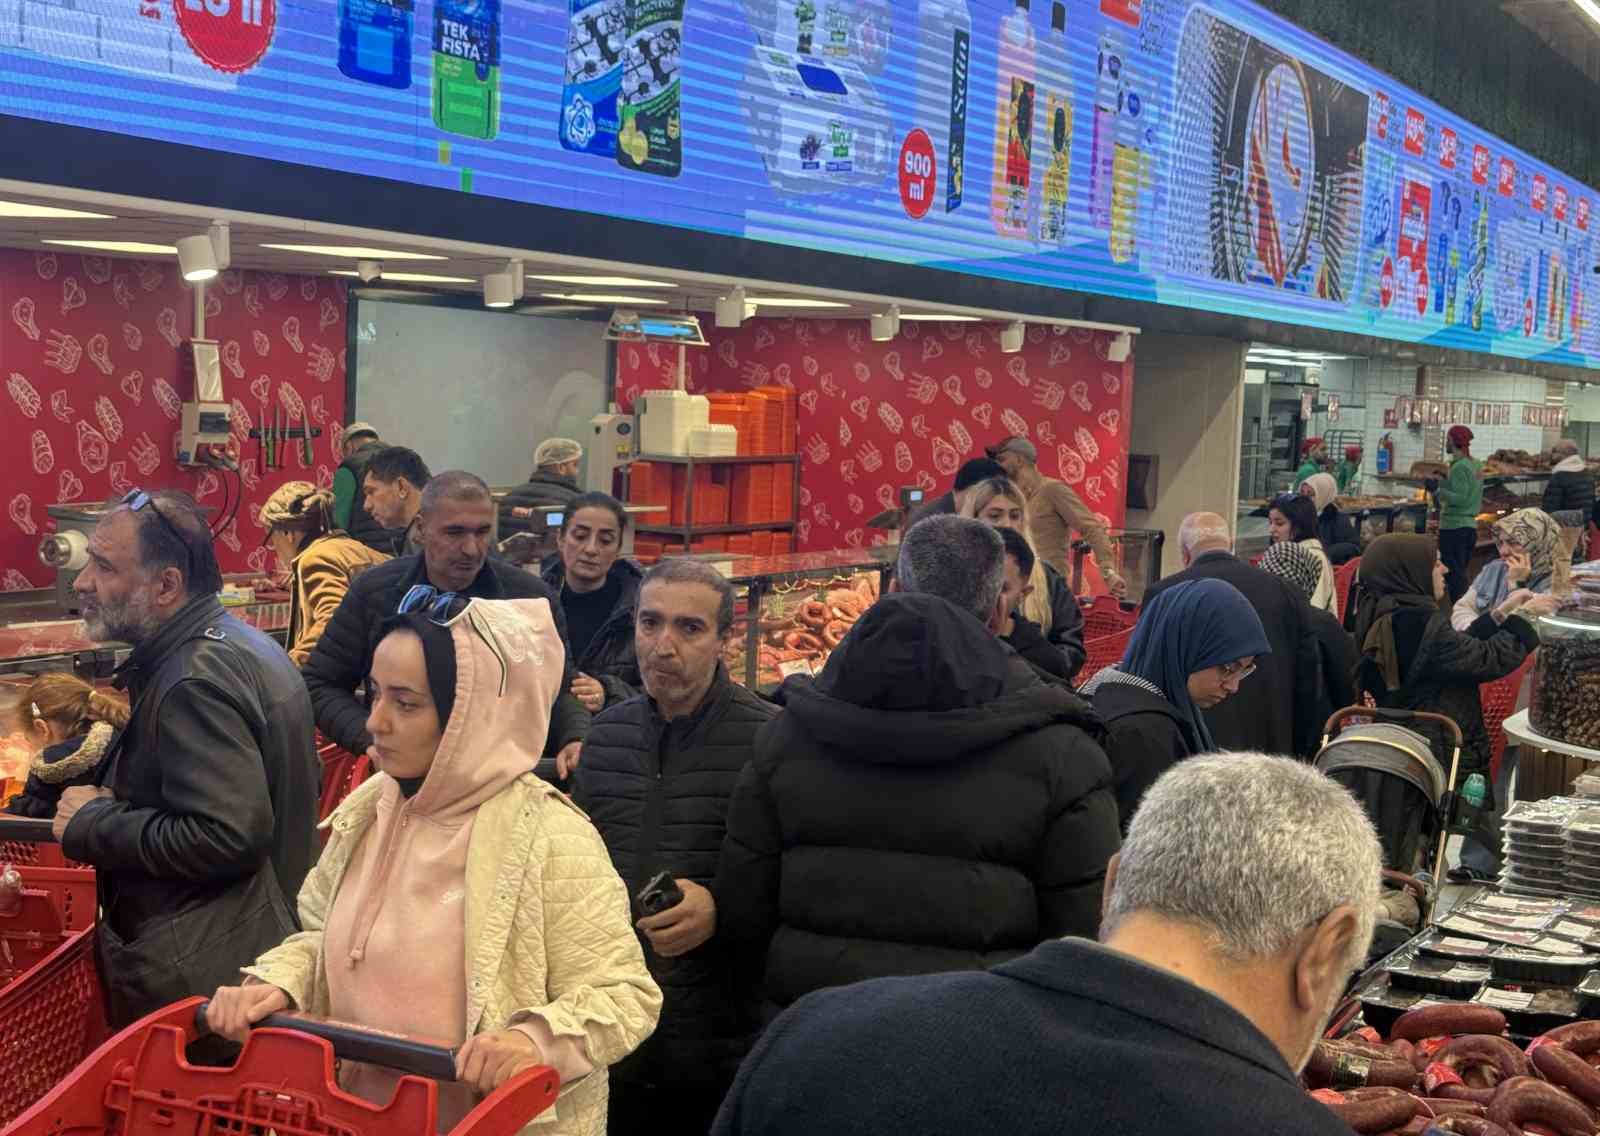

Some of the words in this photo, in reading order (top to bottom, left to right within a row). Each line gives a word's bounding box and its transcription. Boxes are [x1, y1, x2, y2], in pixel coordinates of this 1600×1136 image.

[442, 19, 469, 41] TEK
[441, 36, 481, 61] FISTA
[905, 150, 931, 178] 900
[909, 178, 924, 201] ml
